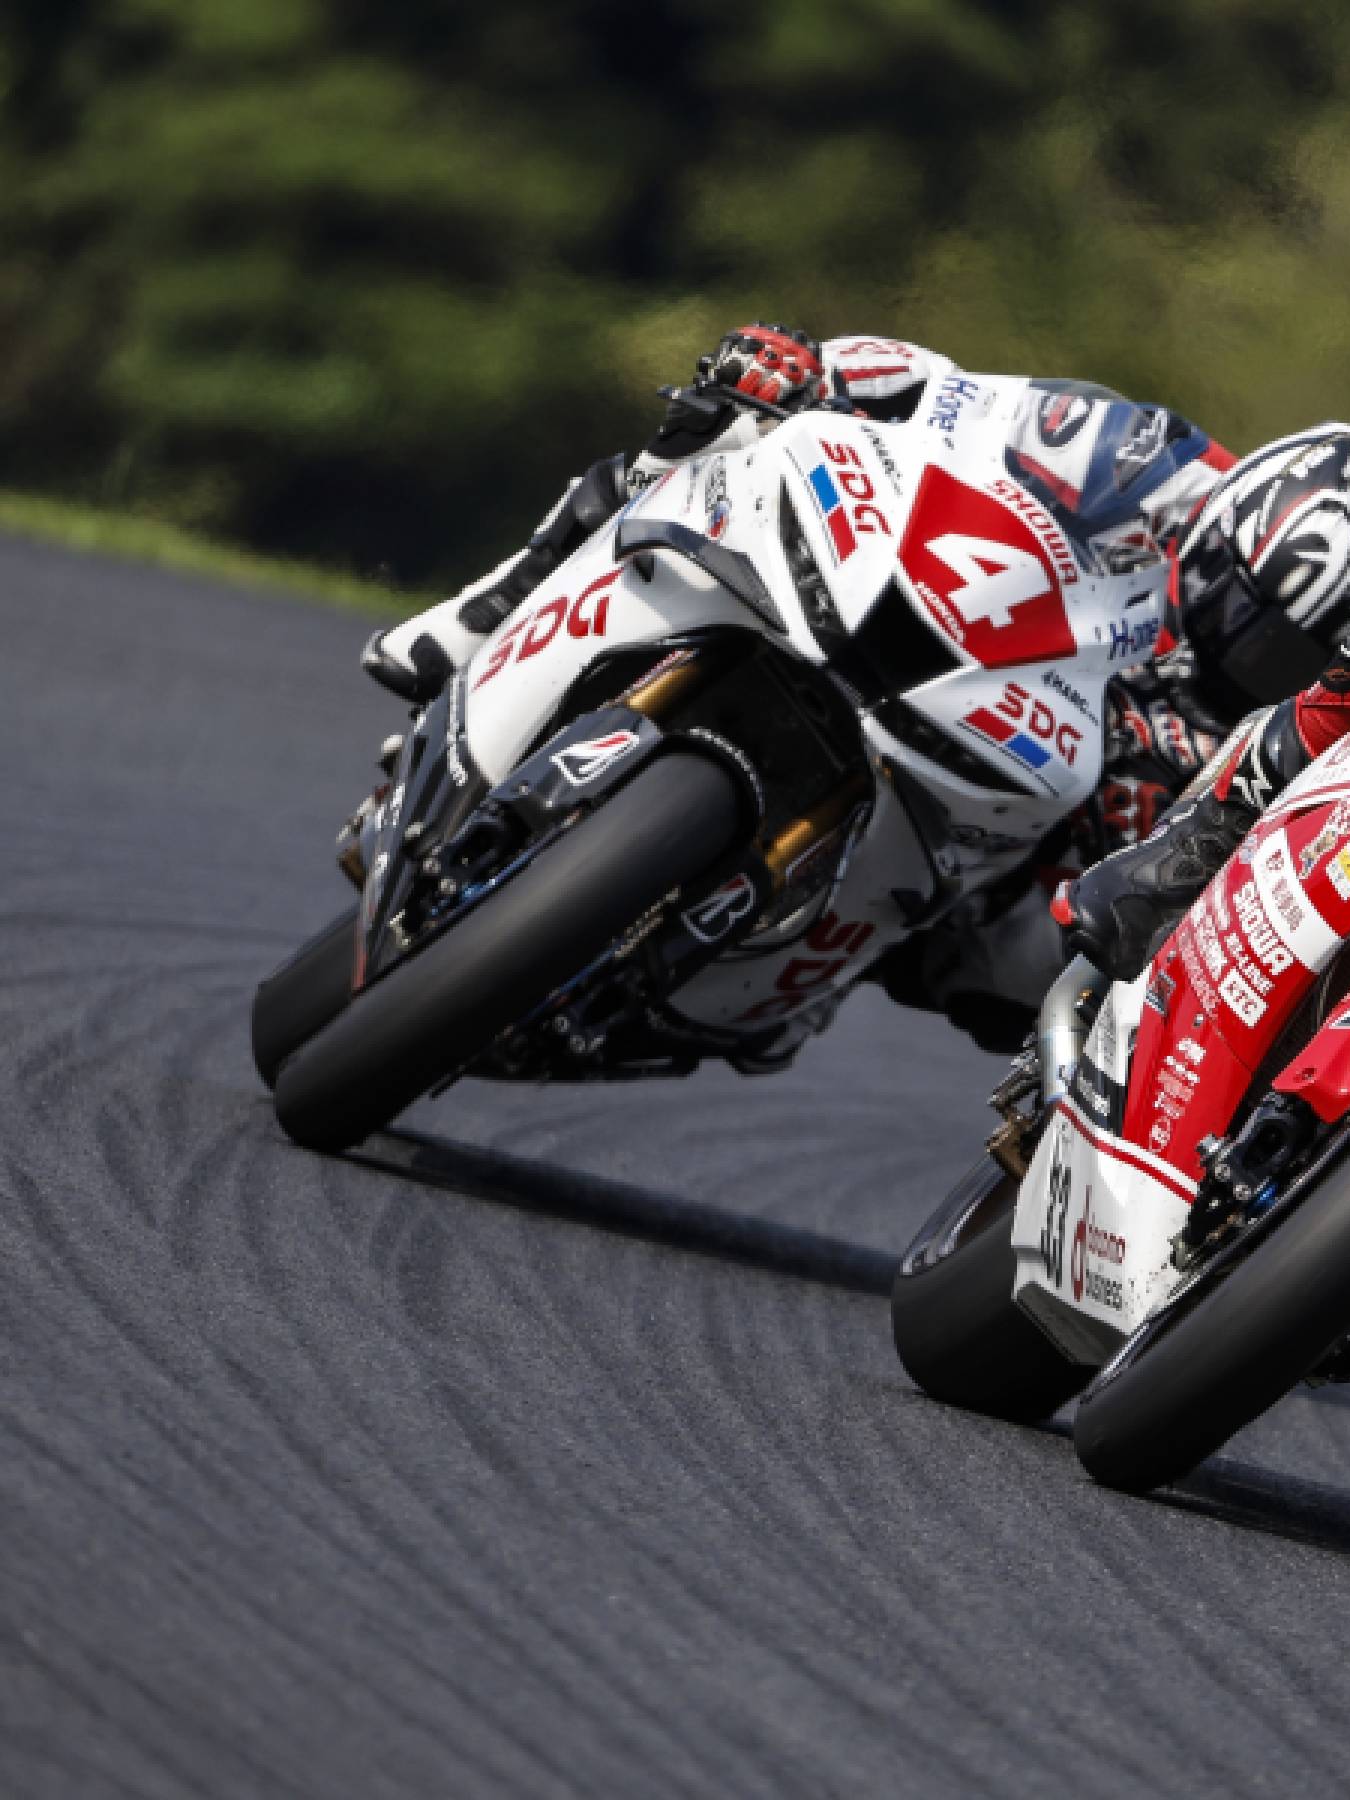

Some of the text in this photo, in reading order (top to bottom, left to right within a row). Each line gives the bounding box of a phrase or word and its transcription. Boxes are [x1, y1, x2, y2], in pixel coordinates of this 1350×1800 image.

[818, 437, 894, 537] SDG
[986, 479, 1079, 585] SHOWA
[472, 568, 625, 692] SDG
[923, 533, 1053, 629] 4
[994, 681, 1084, 768] SDG
[1233, 880, 1298, 976] SHOWA
